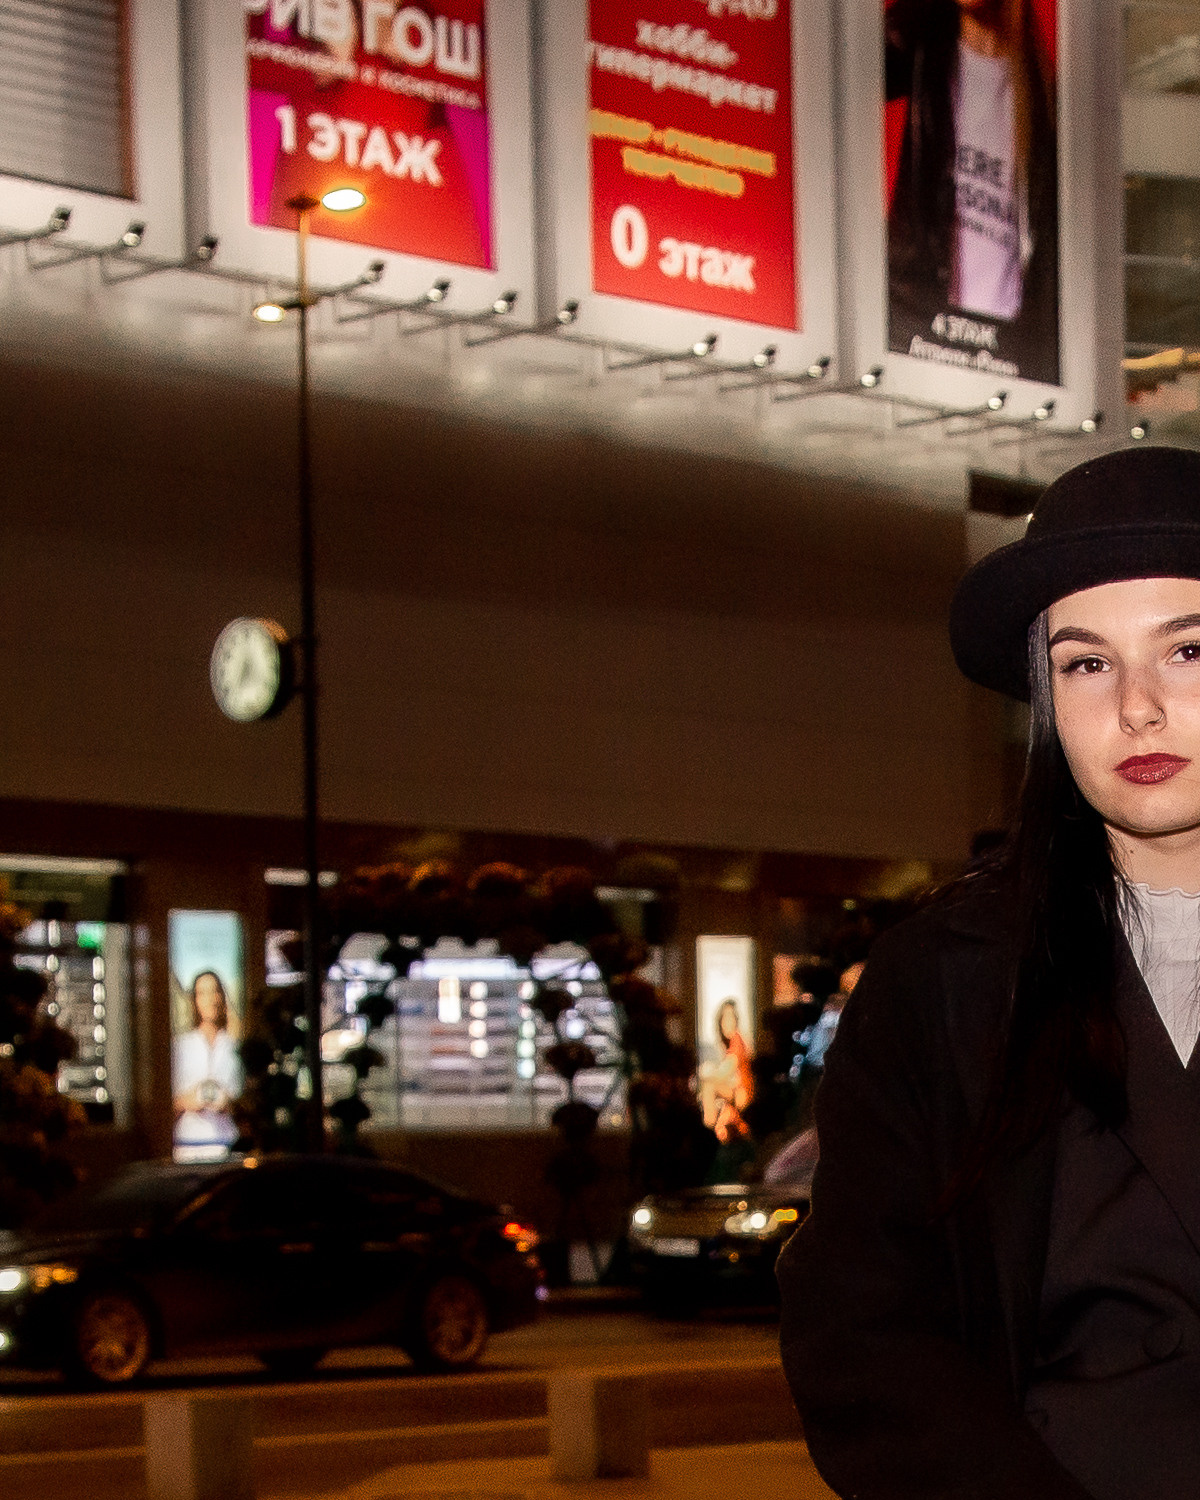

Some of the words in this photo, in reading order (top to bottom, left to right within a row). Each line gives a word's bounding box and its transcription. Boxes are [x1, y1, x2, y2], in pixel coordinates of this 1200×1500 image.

[275, 105, 297, 153] 1
[307, 112, 443, 187] ЭТАЖ
[610, 204, 649, 268] 0
[658, 237, 756, 293] этаж
